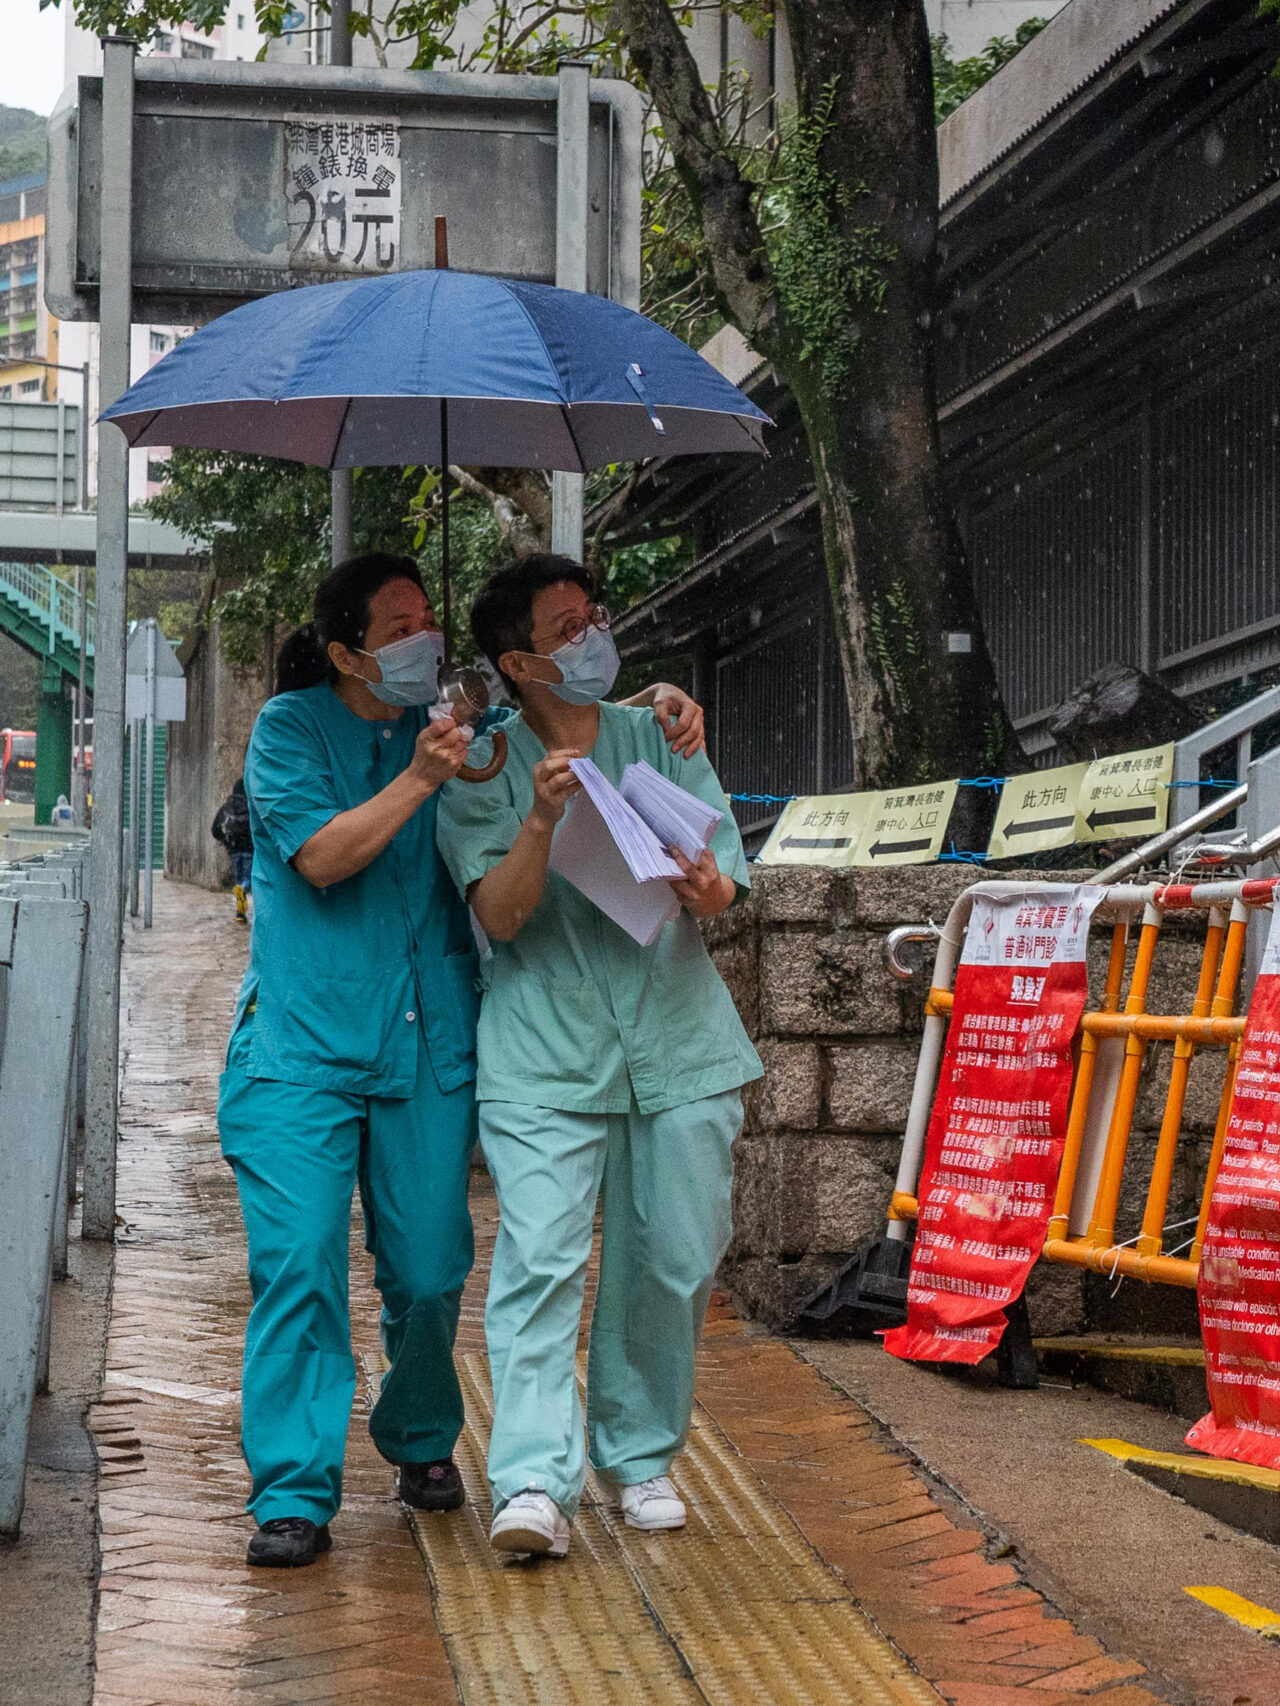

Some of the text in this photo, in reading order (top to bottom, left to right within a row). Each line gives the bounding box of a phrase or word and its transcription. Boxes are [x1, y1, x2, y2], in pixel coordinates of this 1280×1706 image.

[1021, 785, 1067, 810] 此方向
[801, 809, 850, 827] 此方向
[1230, 1115, 1242, 1128] For
[1242, 1118, 1264, 1132] patients
[1266, 1121, 1278, 1133] with
[1262, 1139, 1280, 1153] Please
[1225, 1225, 1238, 1237] with
[1241, 1226, 1264, 1239] chronic
[1219, 1245, 1245, 1258] unstable
[1238, 1265, 1275, 1280] Medication
[1234, 1299, 1248, 1312] with
[1232, 1318, 1255, 1333] doctors
[1255, 1321, 1265, 1333] or
[1224, 1371, 1244, 1384] attend
